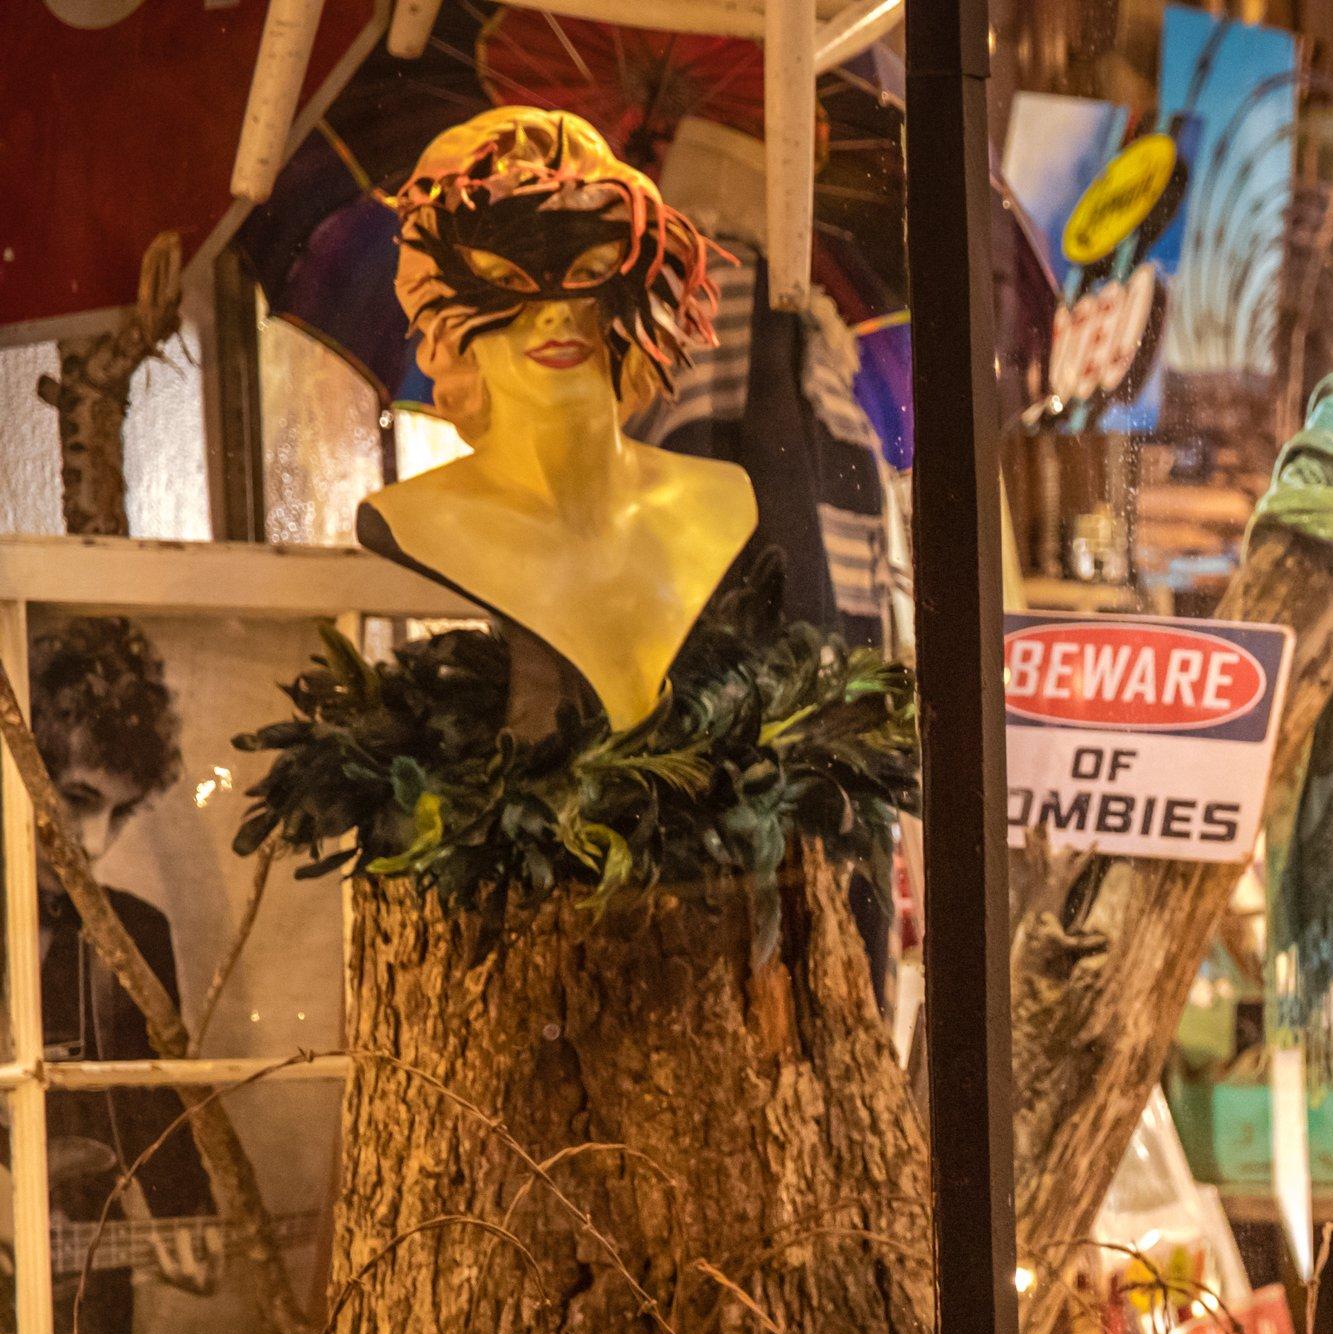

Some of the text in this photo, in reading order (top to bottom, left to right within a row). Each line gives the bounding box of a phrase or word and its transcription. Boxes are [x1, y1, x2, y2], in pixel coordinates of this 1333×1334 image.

[1007, 639, 1241, 711] BEWARE
[1070, 747, 1137, 782] OF
[1007, 787, 1240, 842] OMBIES
